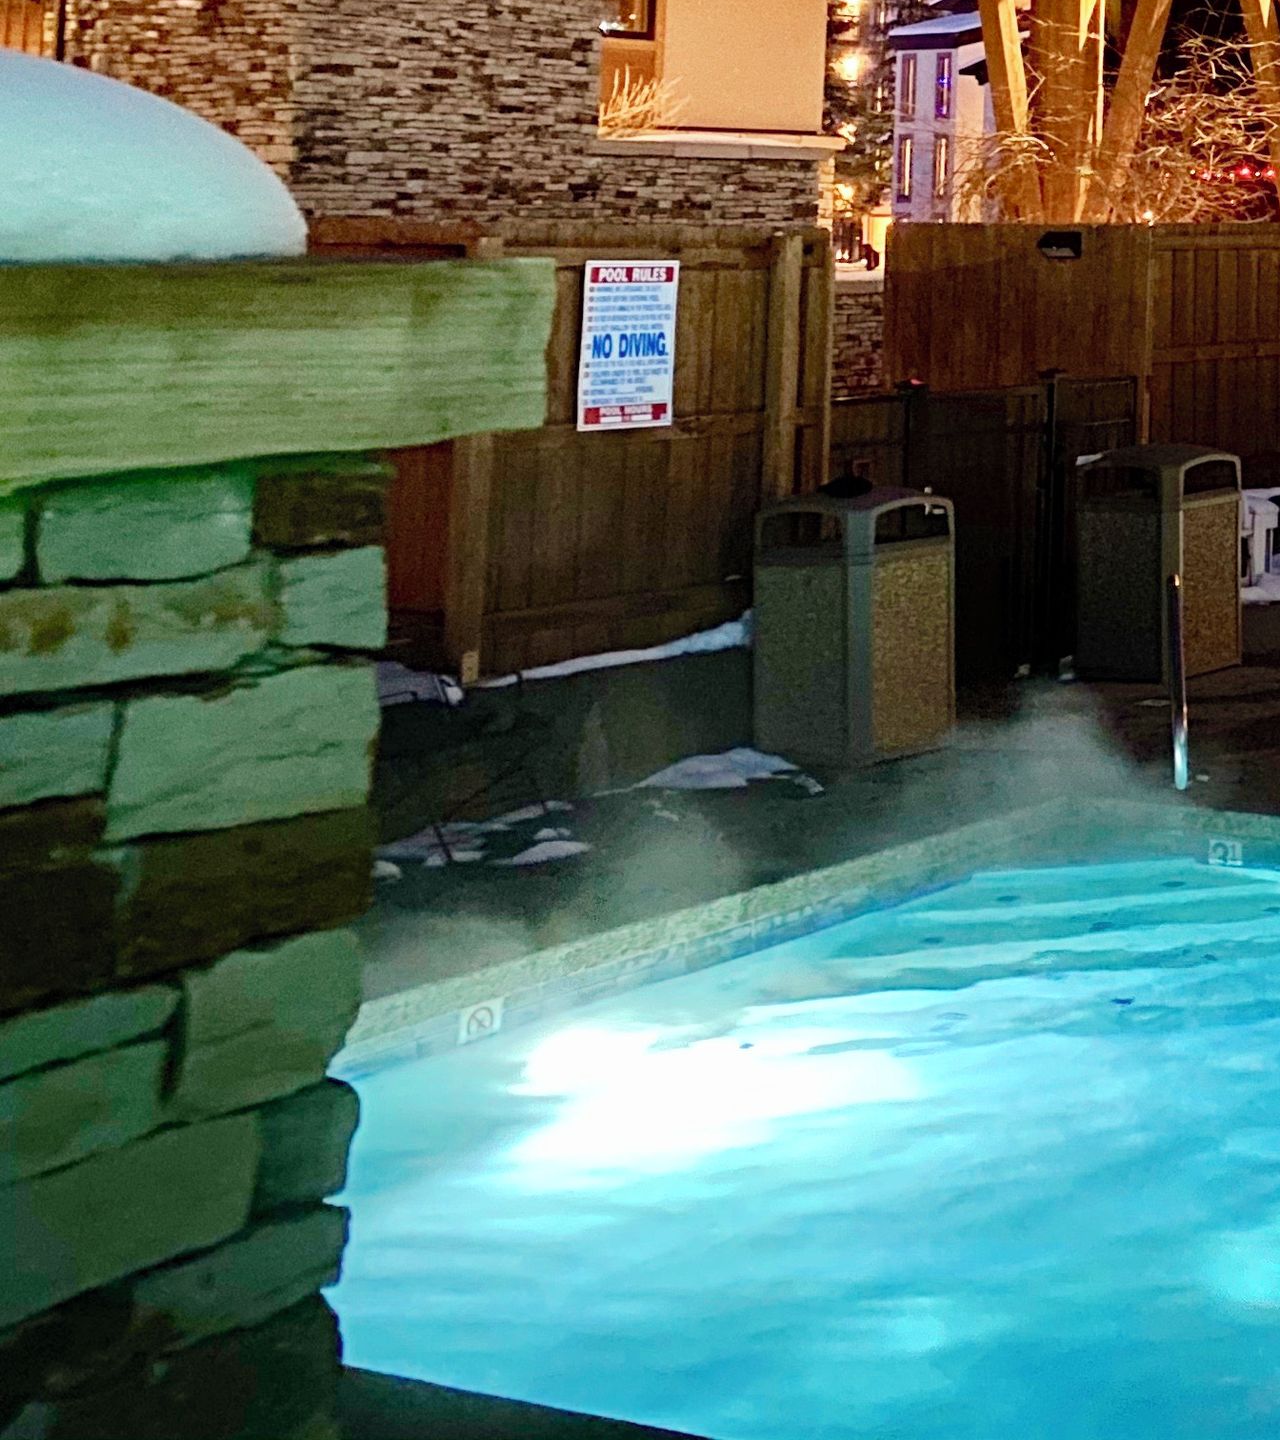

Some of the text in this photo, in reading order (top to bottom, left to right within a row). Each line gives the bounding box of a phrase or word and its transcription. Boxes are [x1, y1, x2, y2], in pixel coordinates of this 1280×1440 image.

[598, 267, 667, 282] POOL RULES
[592, 333, 613, 359] NO
